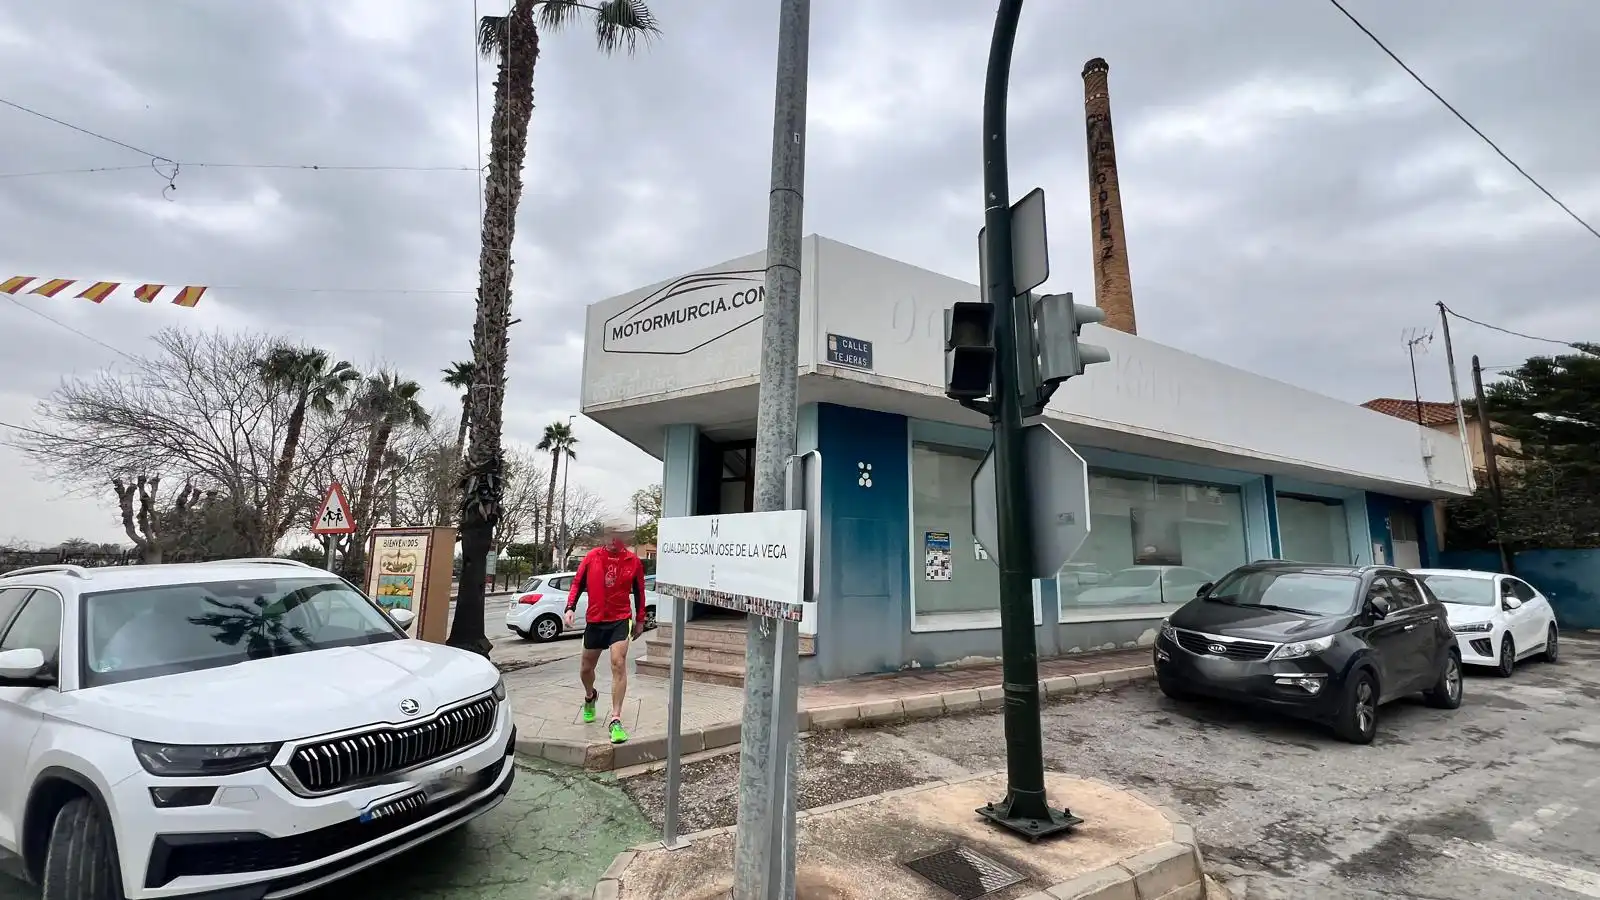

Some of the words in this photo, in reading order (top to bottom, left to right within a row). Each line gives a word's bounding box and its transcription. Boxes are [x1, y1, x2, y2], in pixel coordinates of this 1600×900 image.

[842, 340, 868, 352] CALLE
[833, 352, 867, 366] TEJERAS
[383, 538, 418, 548] BIENVENIDOS
[662, 542, 690, 554] IGUALDAD
[691, 543, 698, 554] ES
[700, 543, 714, 555] SAN
[736, 544, 746, 557] DE
[748, 544, 759, 557] LA
[762, 544, 787, 559] VEGA
